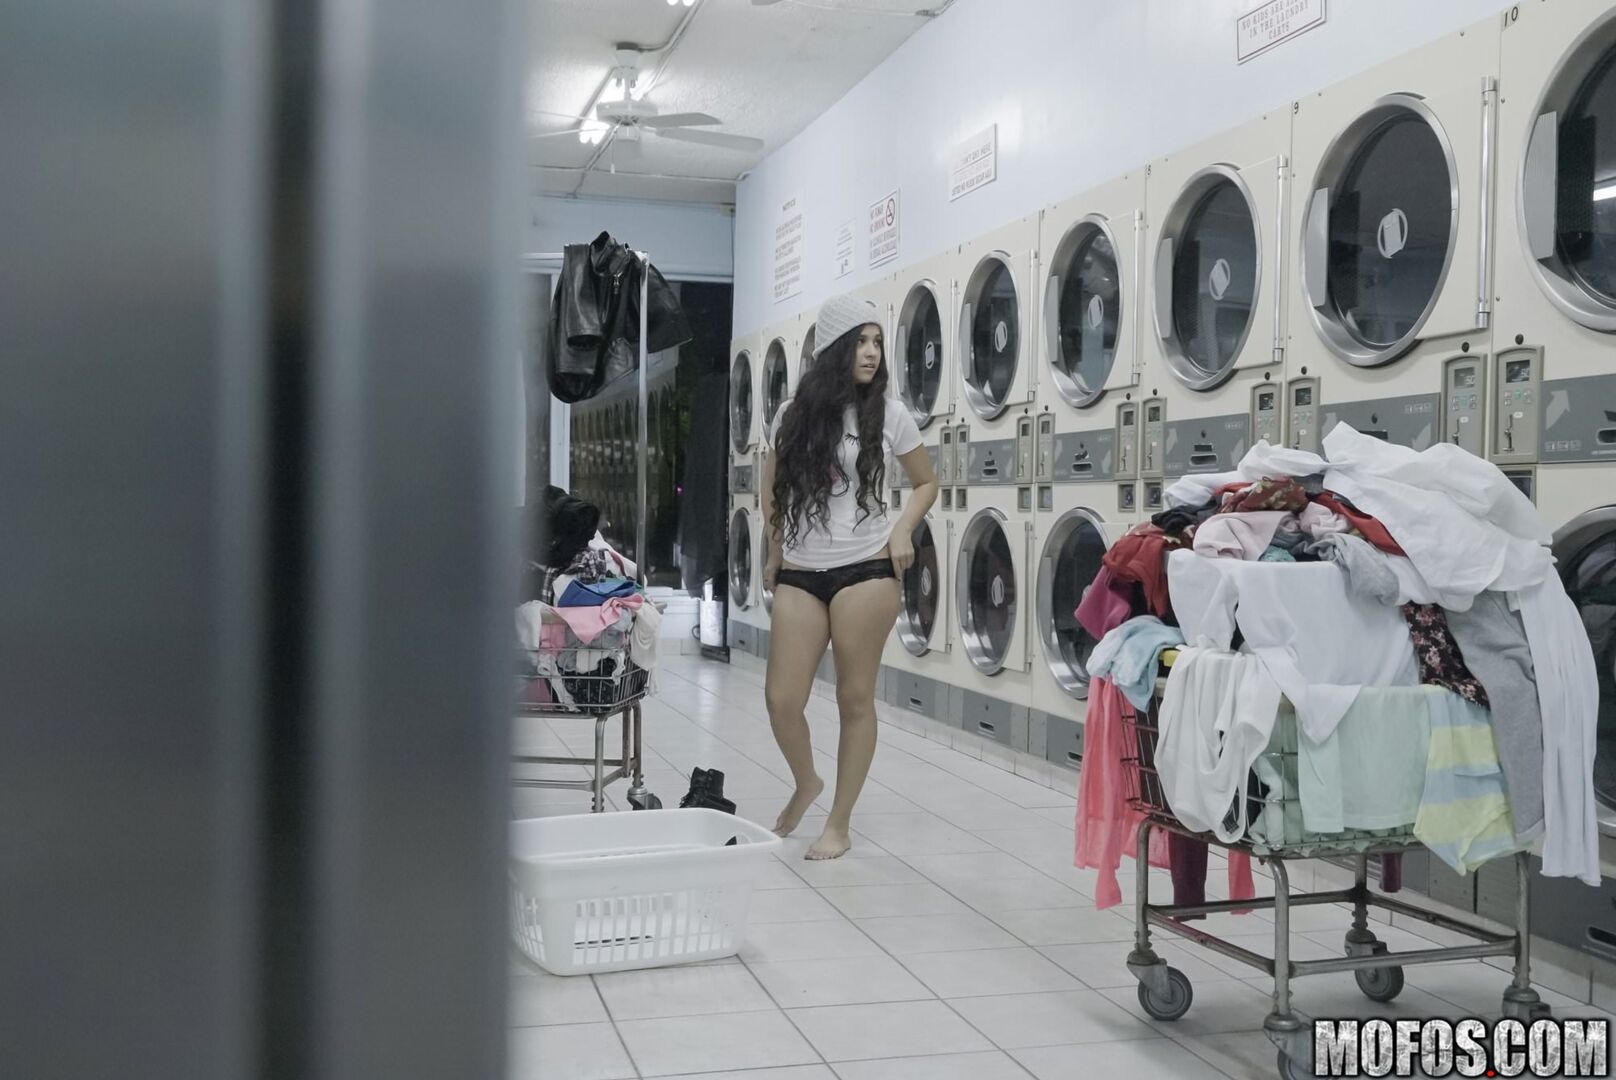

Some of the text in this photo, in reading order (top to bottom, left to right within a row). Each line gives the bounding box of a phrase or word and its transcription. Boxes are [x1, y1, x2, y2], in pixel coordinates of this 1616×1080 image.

[1253, 8, 1269, 25] KIDS
[1260, 17, 1274, 33] THE
[1504, 6, 1519, 27] 10
[1268, 21, 1290, 40] CARTS
[1294, 101, 1299, 115] 9
